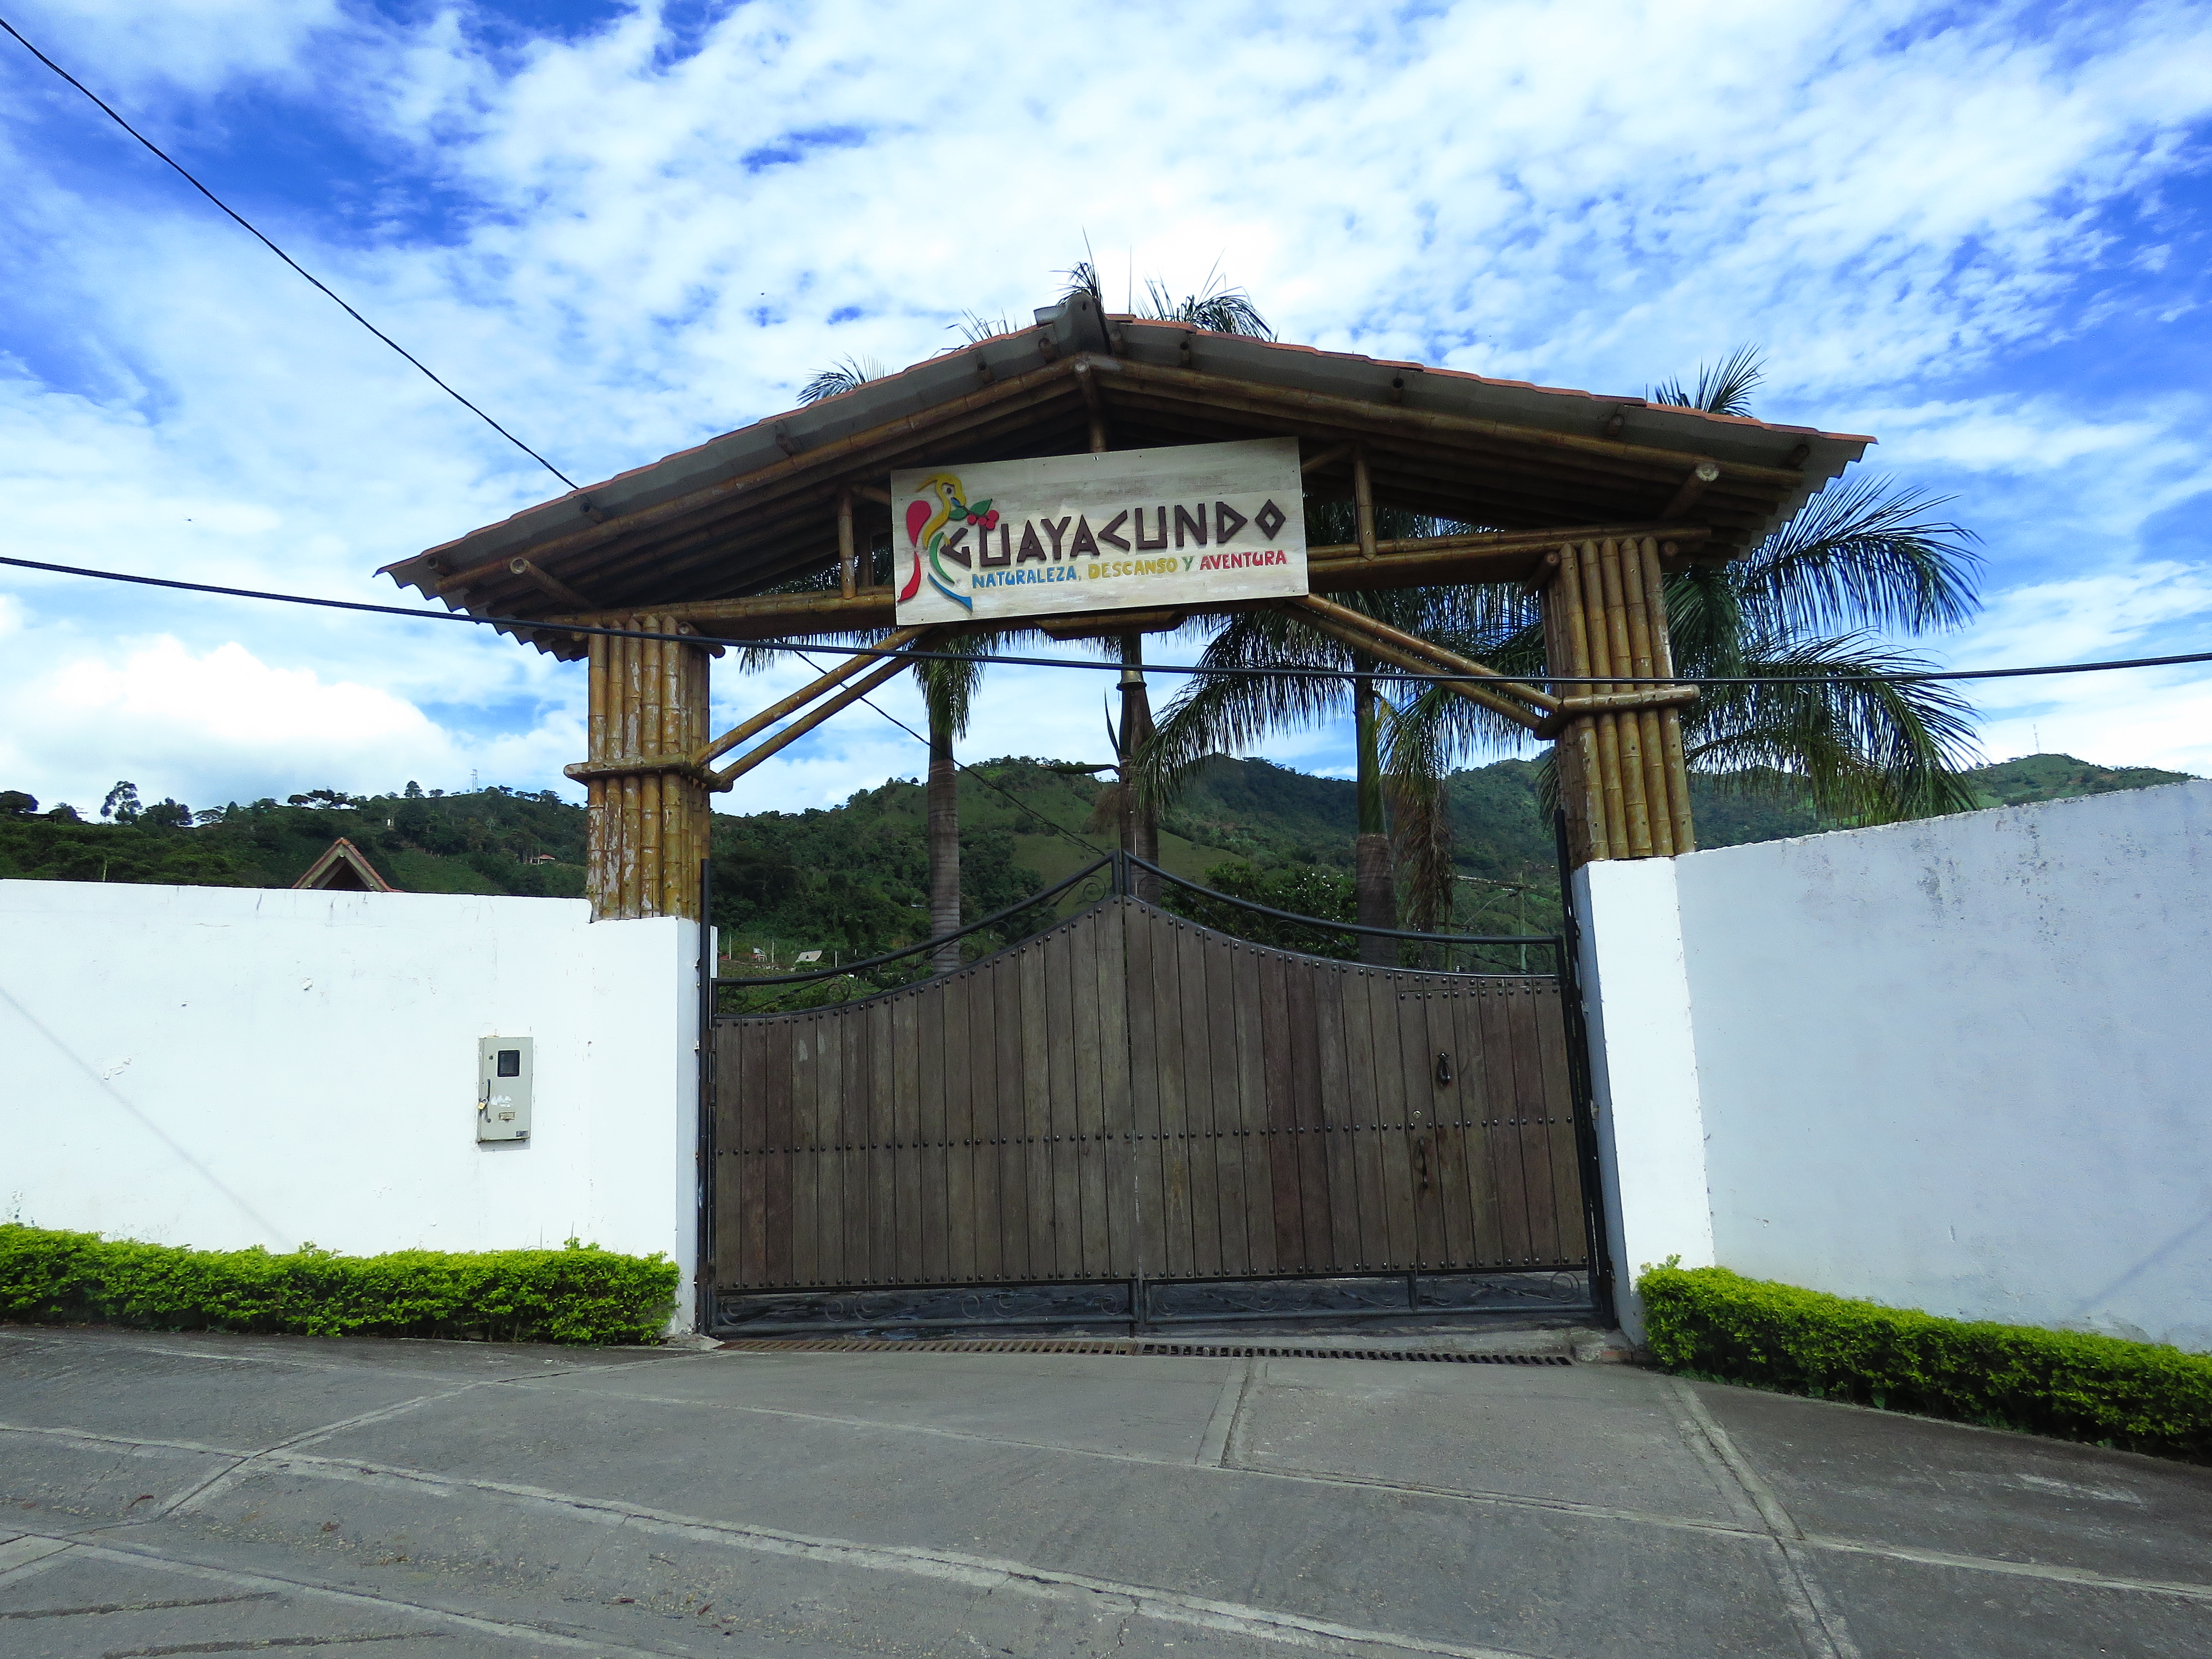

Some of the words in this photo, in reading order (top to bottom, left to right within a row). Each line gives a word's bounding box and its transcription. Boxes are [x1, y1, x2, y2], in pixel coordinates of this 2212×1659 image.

[940, 499, 1286, 567] GUAYACUNDO
[972, 565, 1082, 589] NATURALEZA,
[1089, 557, 1177, 579] DESCANSO
[1181, 555, 1194, 571] Y
[1200, 550, 1286, 570] AVENTURA
